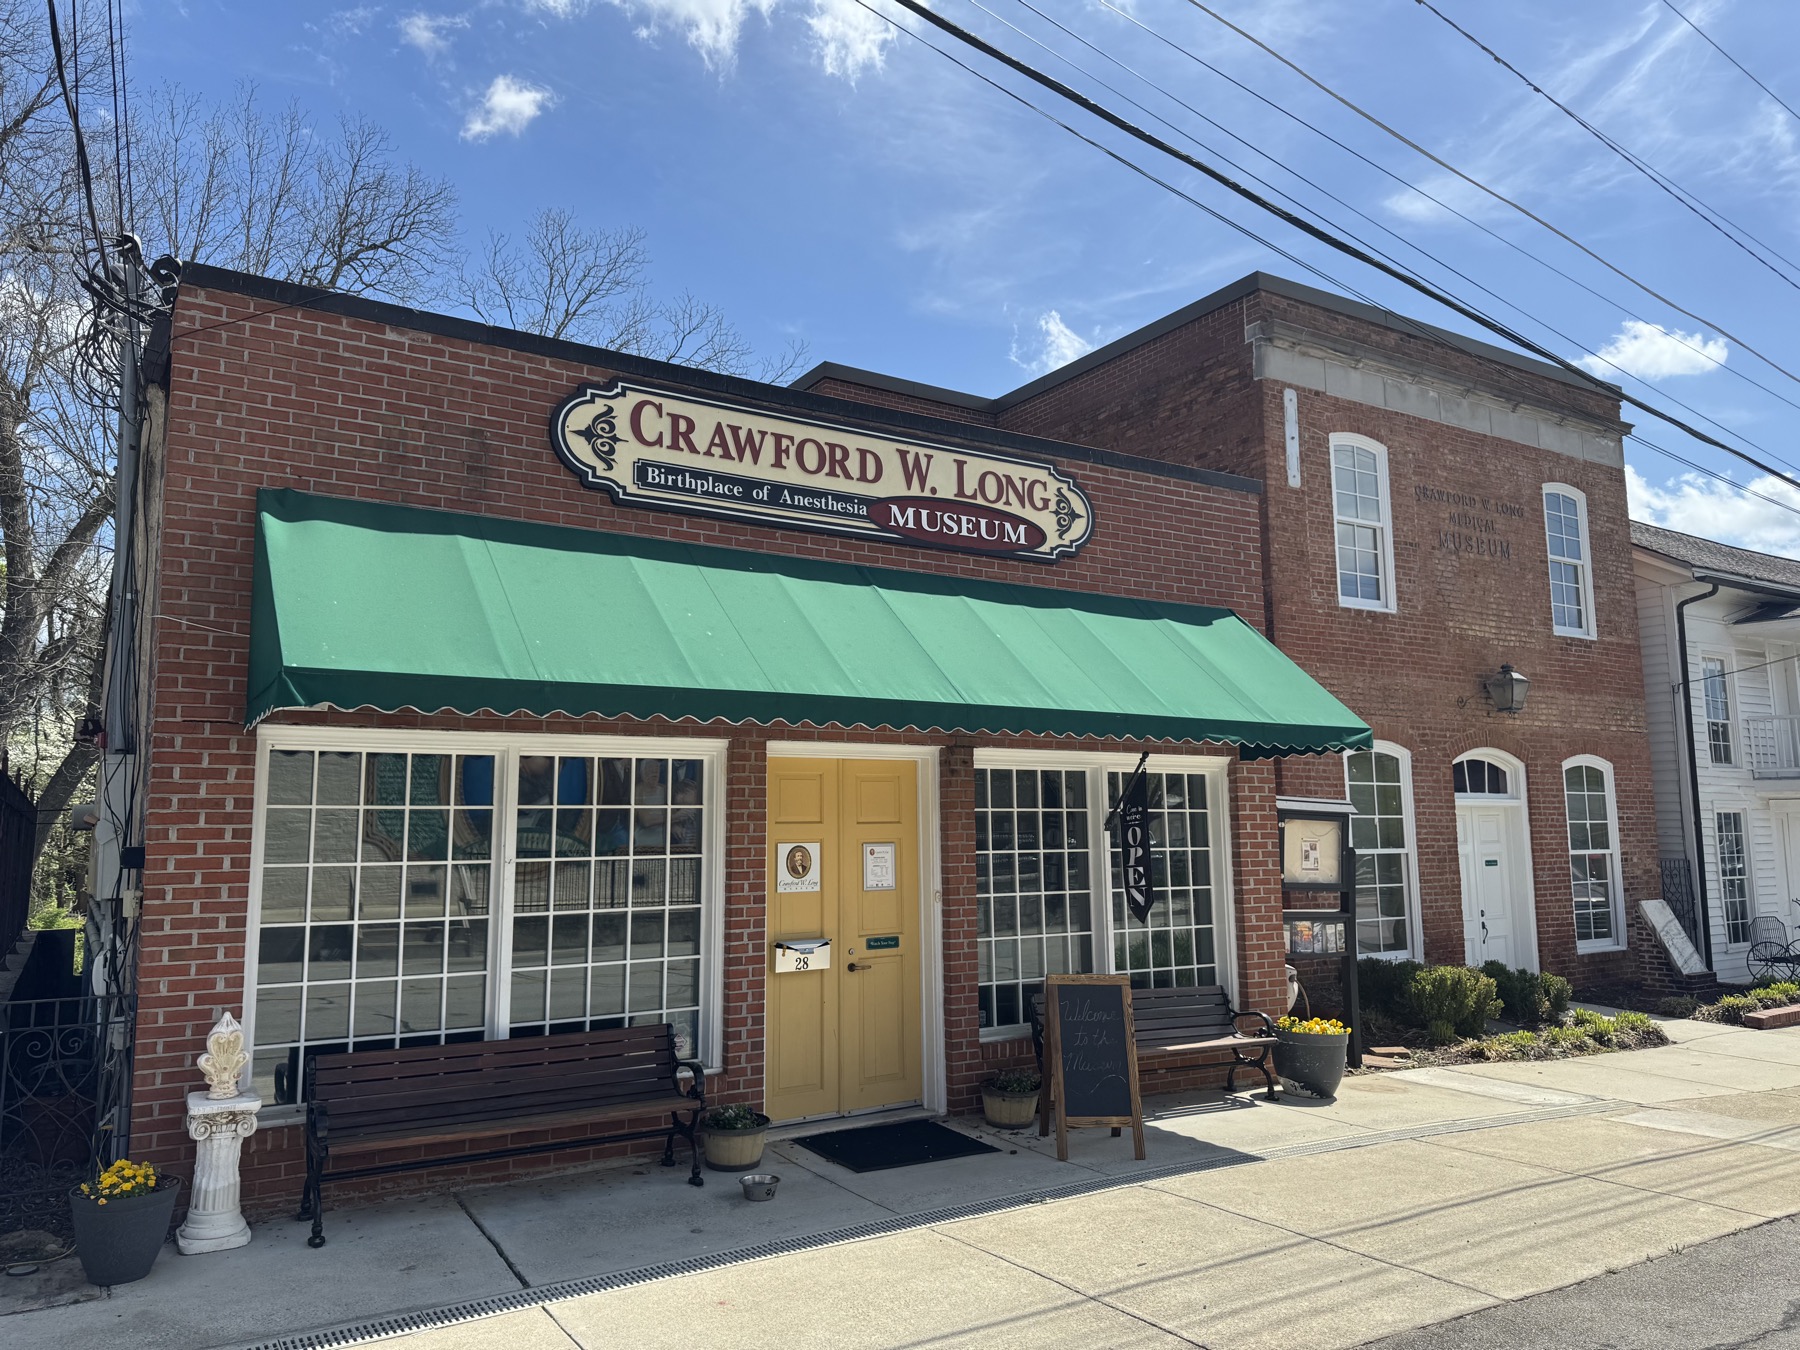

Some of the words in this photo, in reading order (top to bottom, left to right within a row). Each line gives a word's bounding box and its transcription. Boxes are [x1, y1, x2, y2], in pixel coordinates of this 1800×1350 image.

[630, 400, 883, 484] CRAWFORD
[896, 448, 938, 495] W.
[953, 459, 1051, 512] LONG
[646, 466, 743, 496] Birthplace
[753, 485, 771, 500] of
[779, 489, 867, 515] Anesthesia
[1414, 486, 1476, 507] CRAWFORD
[1495, 501, 1524, 518] LONG
[888, 504, 1028, 545] MUSEUM
[1449, 512, 1496, 533] MEDICAL
[1439, 530, 1510, 560] MUSEUM
[1126, 826, 1147, 907] OPEN
[795, 956, 809, 970] 28
[1073, 1026, 1088, 1046] to
